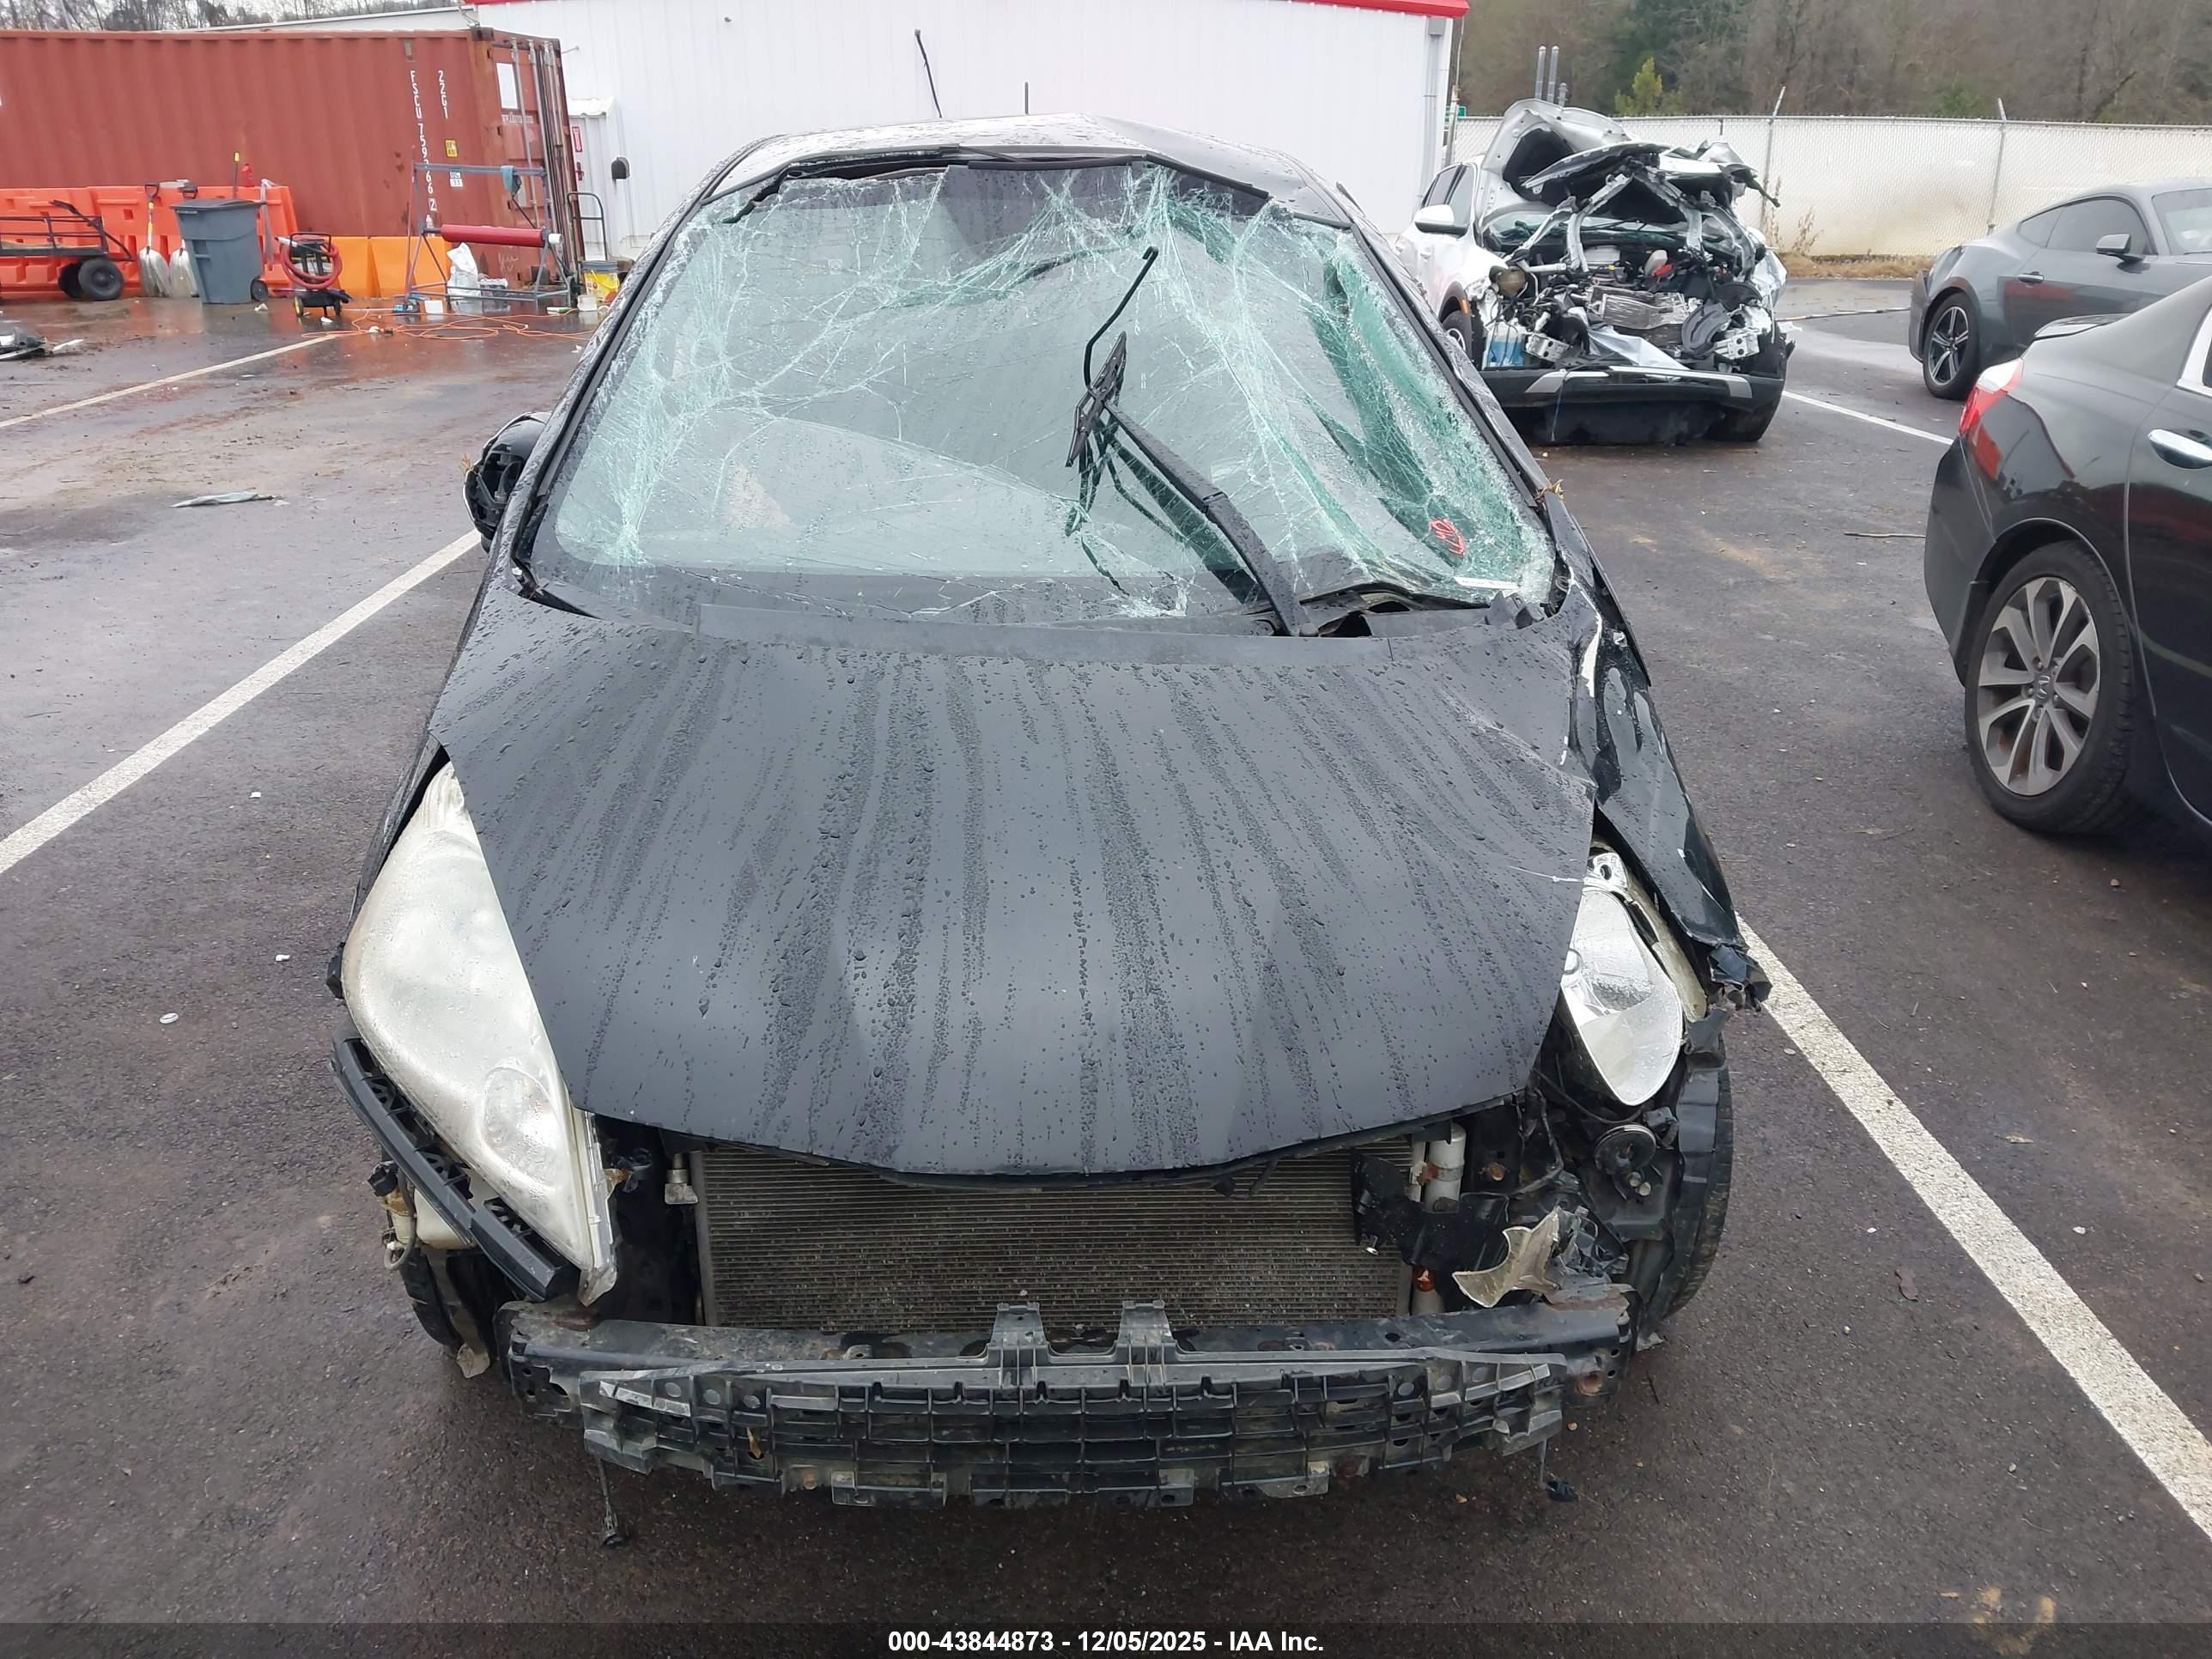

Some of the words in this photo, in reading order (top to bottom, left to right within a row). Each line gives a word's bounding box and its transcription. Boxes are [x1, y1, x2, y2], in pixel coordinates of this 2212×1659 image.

[410, 70, 422, 119] FSCU
[429, 198, 438, 211] 2
[437, 70, 448, 119] 22G1
